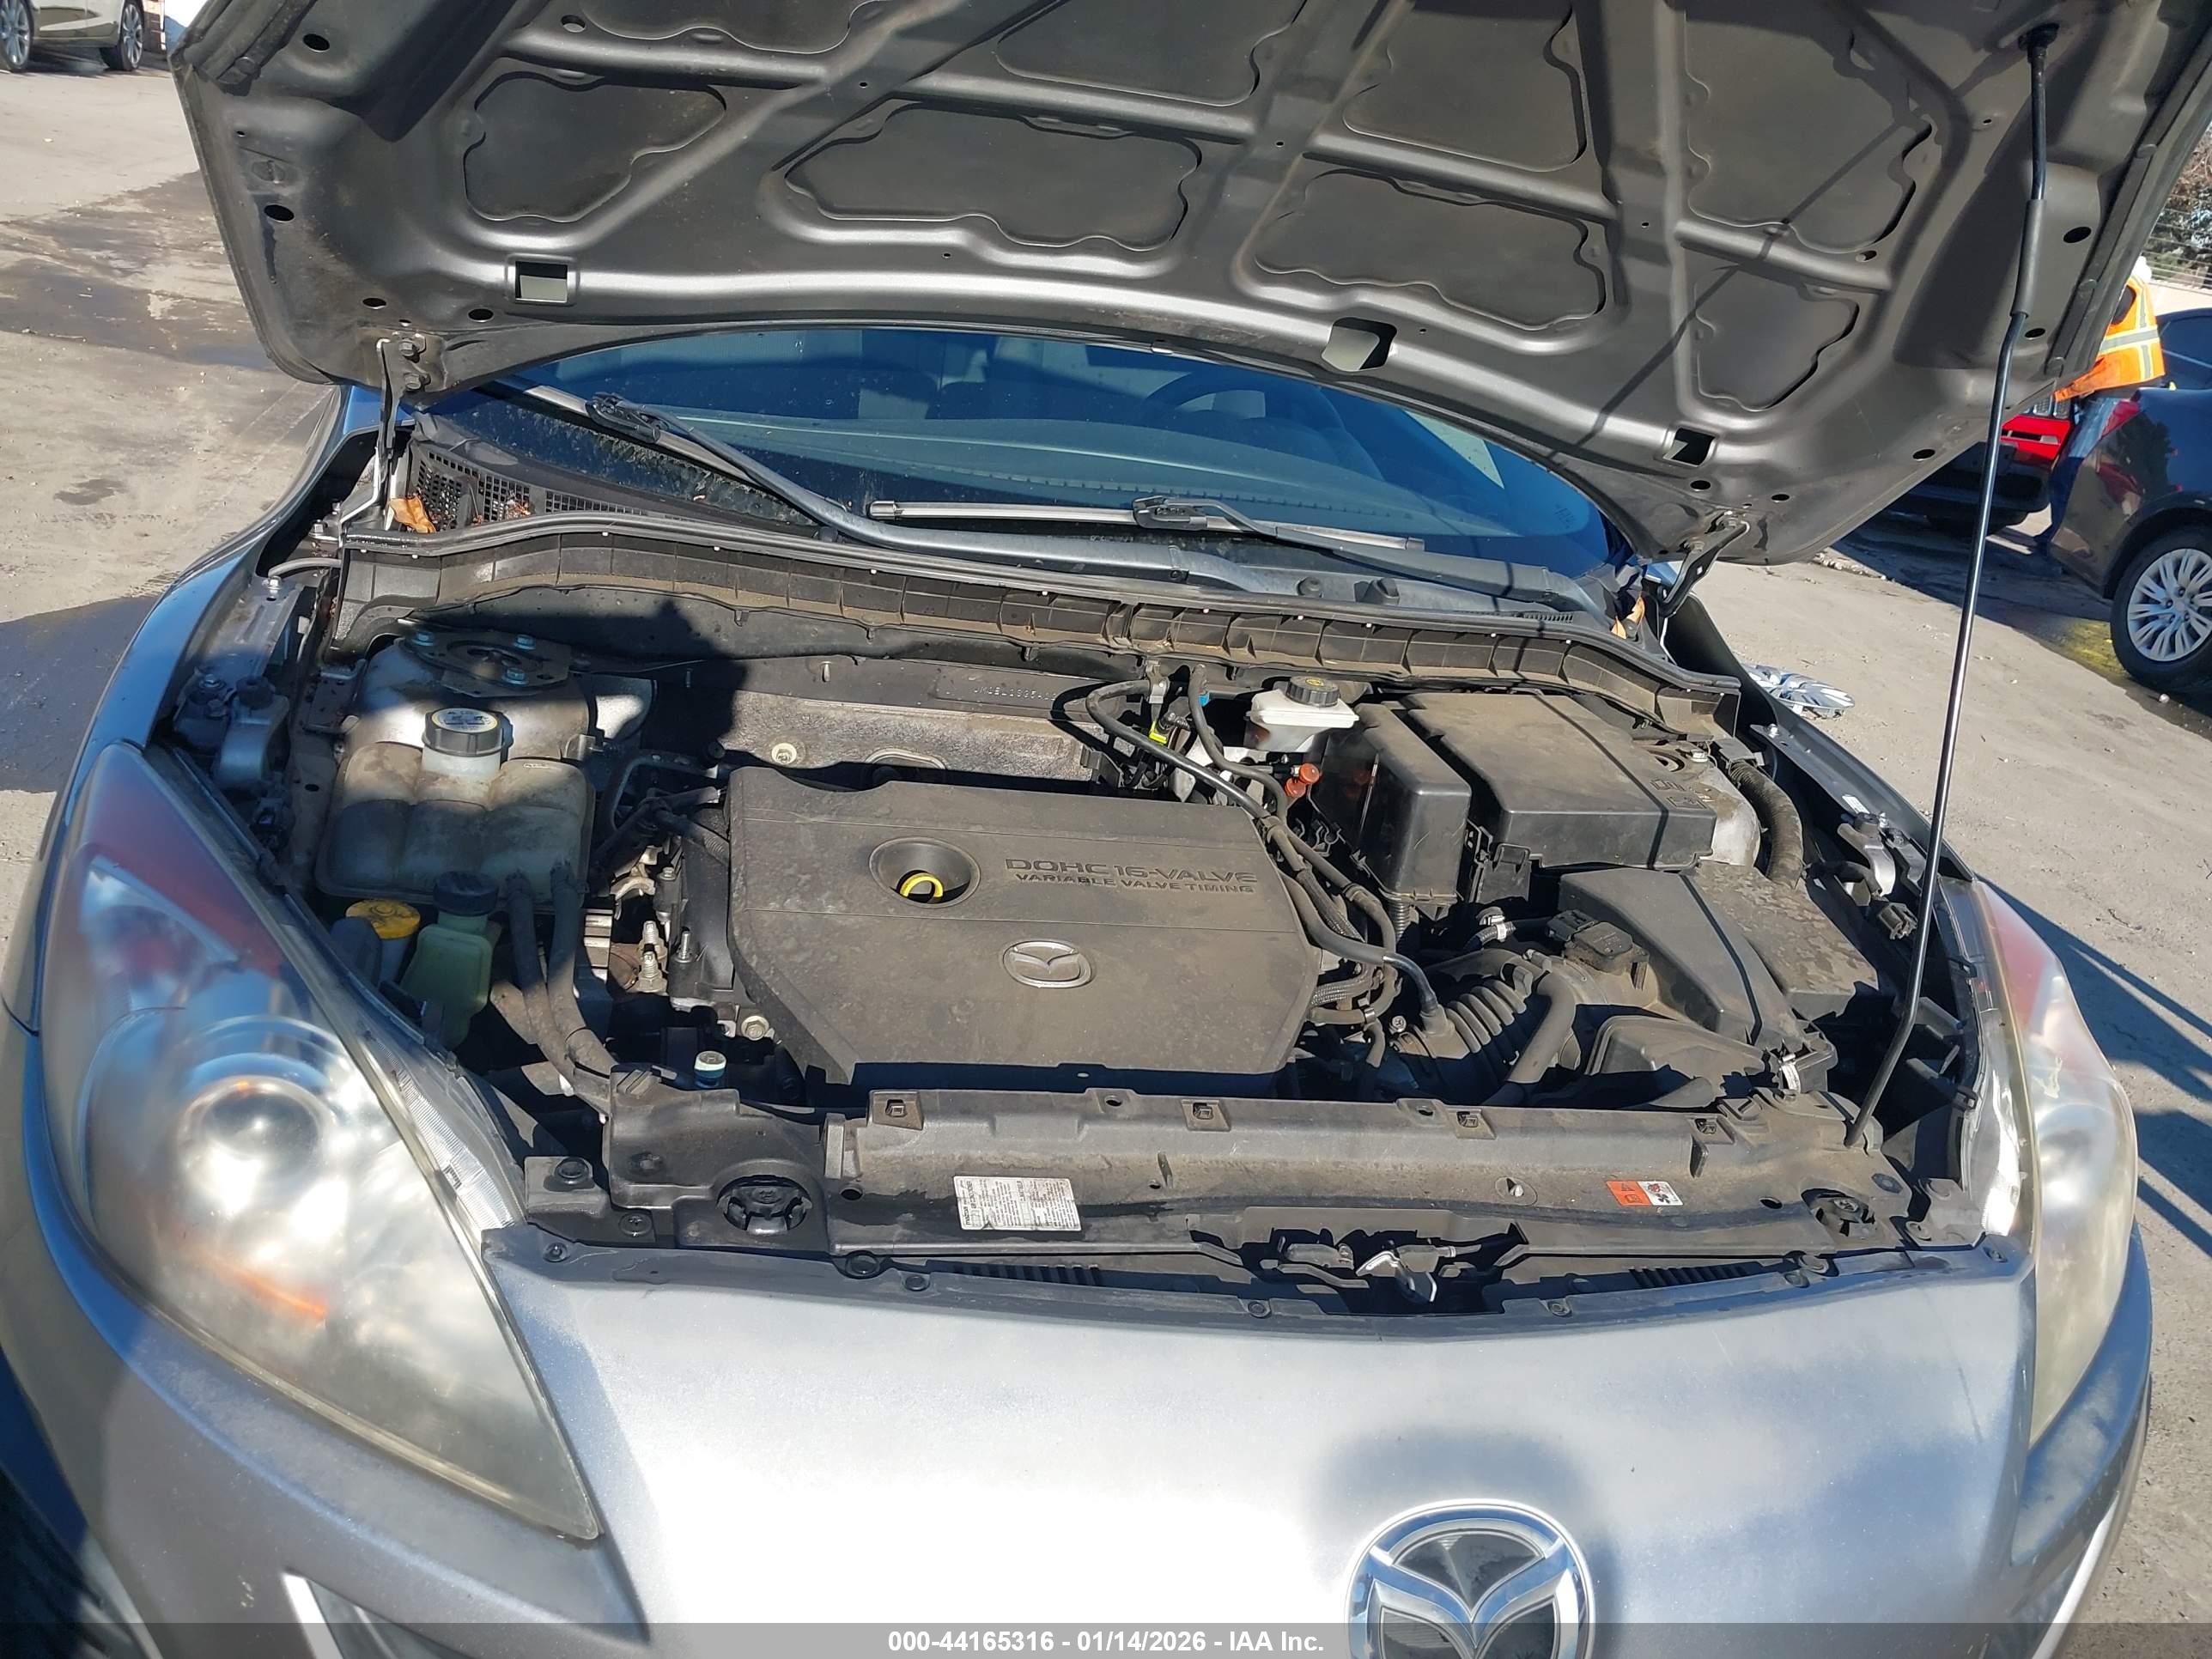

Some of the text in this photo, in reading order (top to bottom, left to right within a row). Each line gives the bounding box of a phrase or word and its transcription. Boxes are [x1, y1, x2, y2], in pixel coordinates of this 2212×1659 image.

[1006, 859, 1257, 883] DOHC 16-VALVE
[1016, 873, 1255, 893] VARIABLE VALVE TIMING
